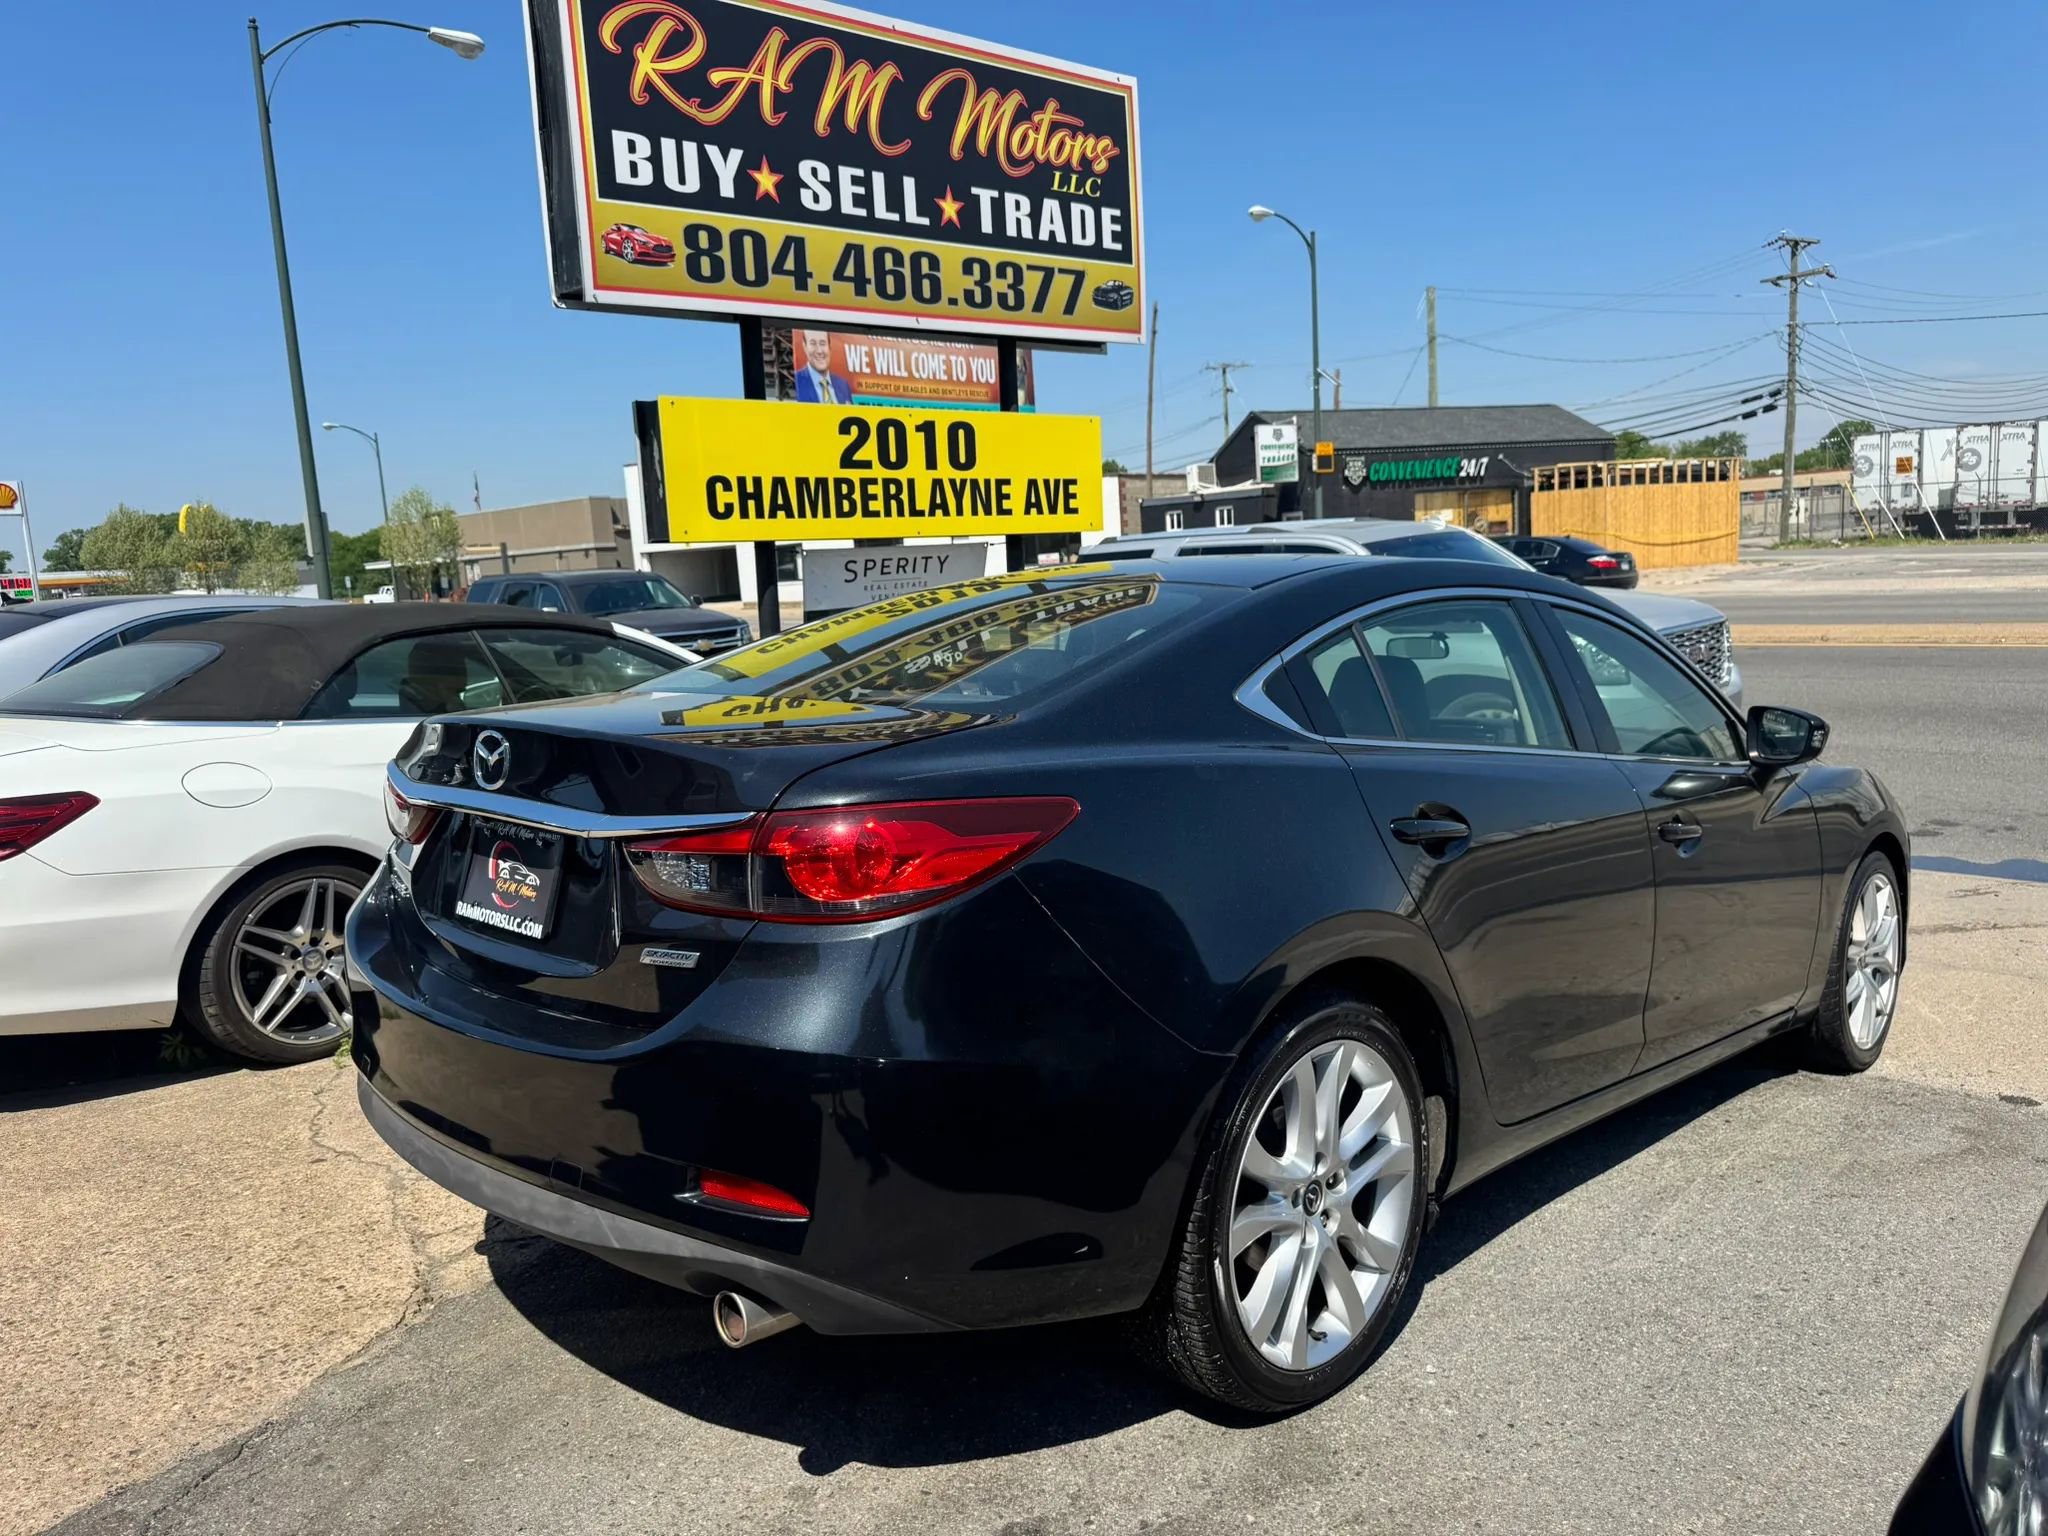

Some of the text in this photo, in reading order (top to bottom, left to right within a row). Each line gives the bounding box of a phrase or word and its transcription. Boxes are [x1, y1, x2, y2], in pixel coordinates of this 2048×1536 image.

[599, 0, 1120, 177] RAM Motors
[612, 130, 1123, 250] BUY SELL TRADE
[1051, 171, 1101, 197] LLC
[683, 223, 1088, 315] 804.466.3377
[844, 344, 996, 384] WE WILL COME TO YOU
[865, 381, 892, 391] SUPPORT
[894, 383, 901, 391] OF
[902, 384, 927, 394] BEAGLES
[929, 387, 940, 395] AND
[838, 416, 976, 472] 2010
[1890, 440, 1913, 449] XTRA
[1966, 435, 1989, 445] XTRA
[2000, 432, 2026, 442] XTRA
[1369, 456, 1461, 481] CONVENIENCE
[1459, 456, 1489, 478] 24/7
[705, 475, 1079, 520] CHAMBERLAYNE AVE
[844, 555, 949, 583] SPERITY
[894, 581, 928, 589] ESTATE
[517, 883, 537, 898] Motors
